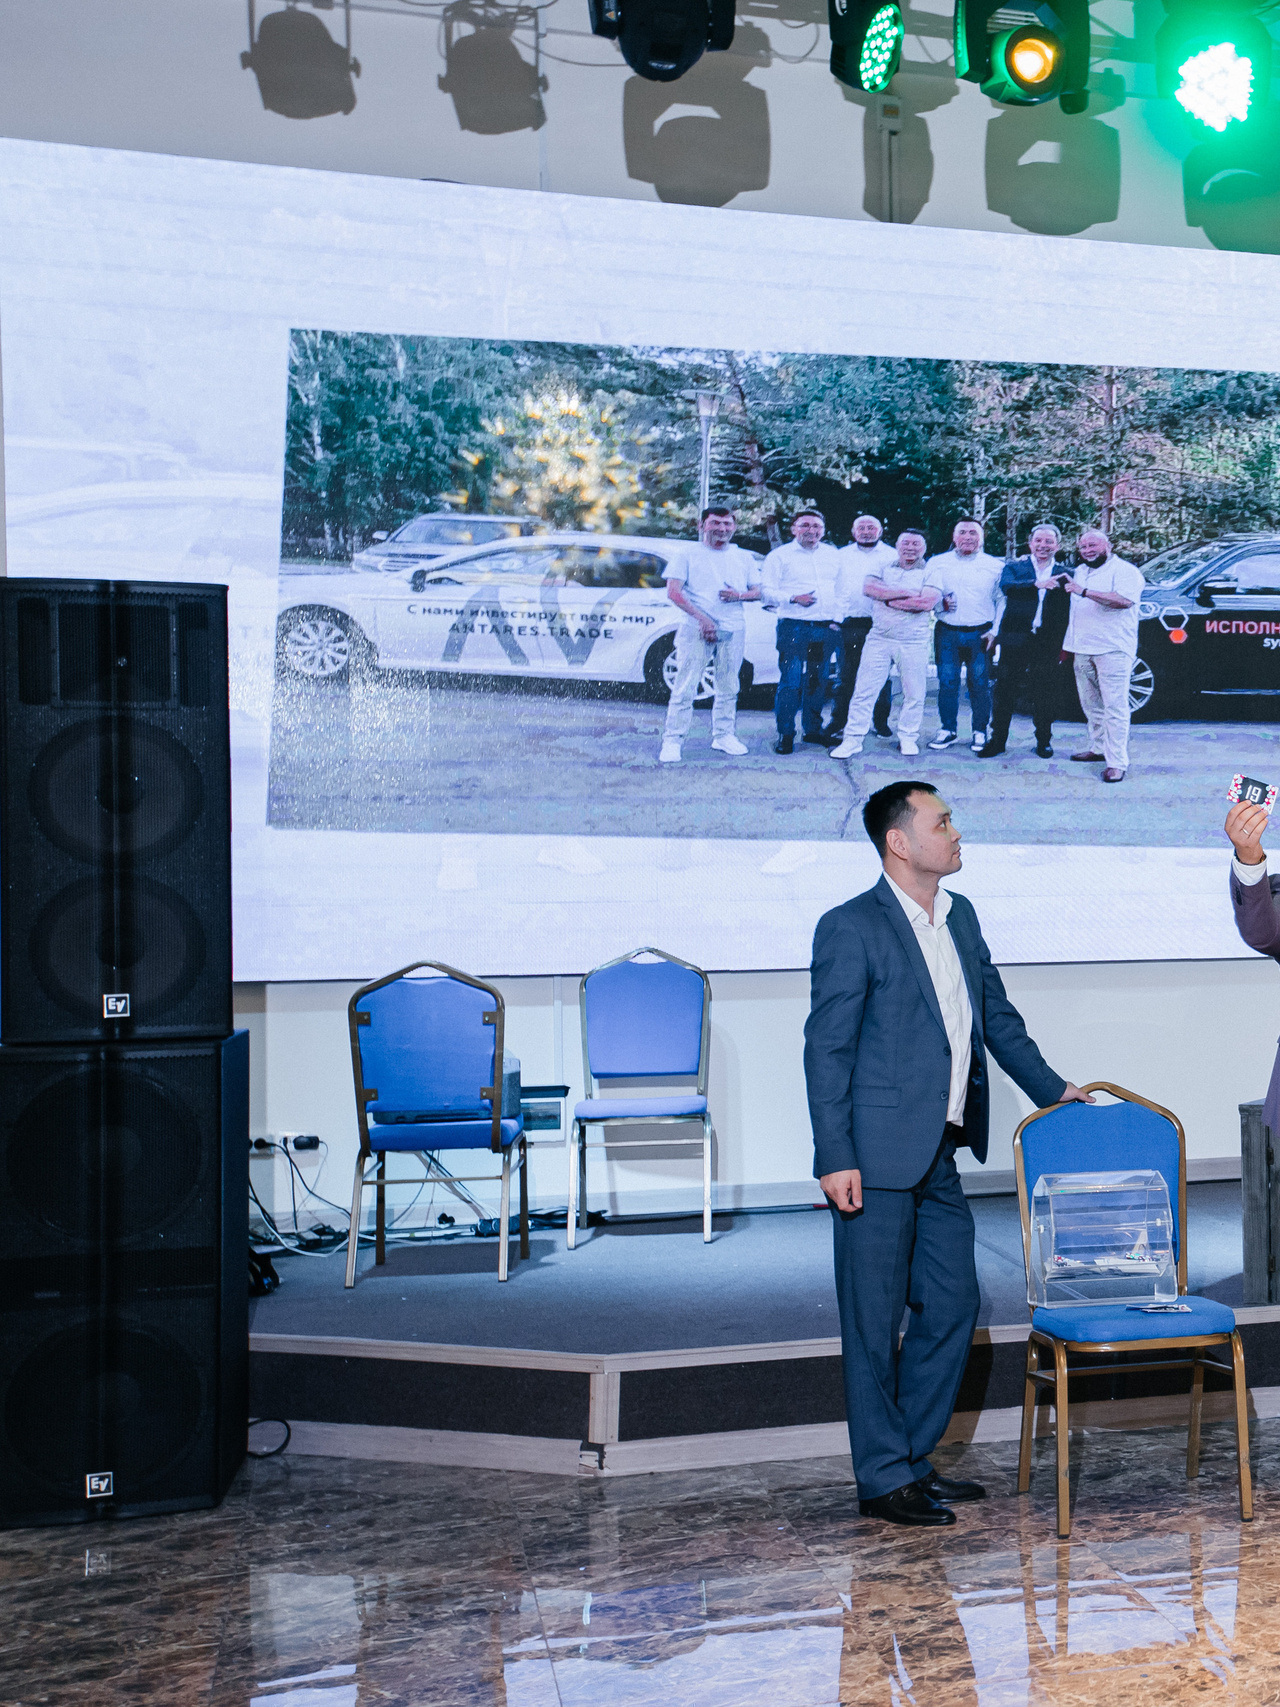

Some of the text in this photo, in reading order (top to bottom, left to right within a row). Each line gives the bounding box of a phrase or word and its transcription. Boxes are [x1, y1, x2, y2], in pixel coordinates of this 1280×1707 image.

[407, 604, 416, 614] С
[422, 607, 464, 616] нами
[581, 613, 617, 623] весь
[622, 616, 656, 626] мир
[449, 622, 614, 640] ANTARES.TRADE
[1245, 784, 1262, 803] 19
